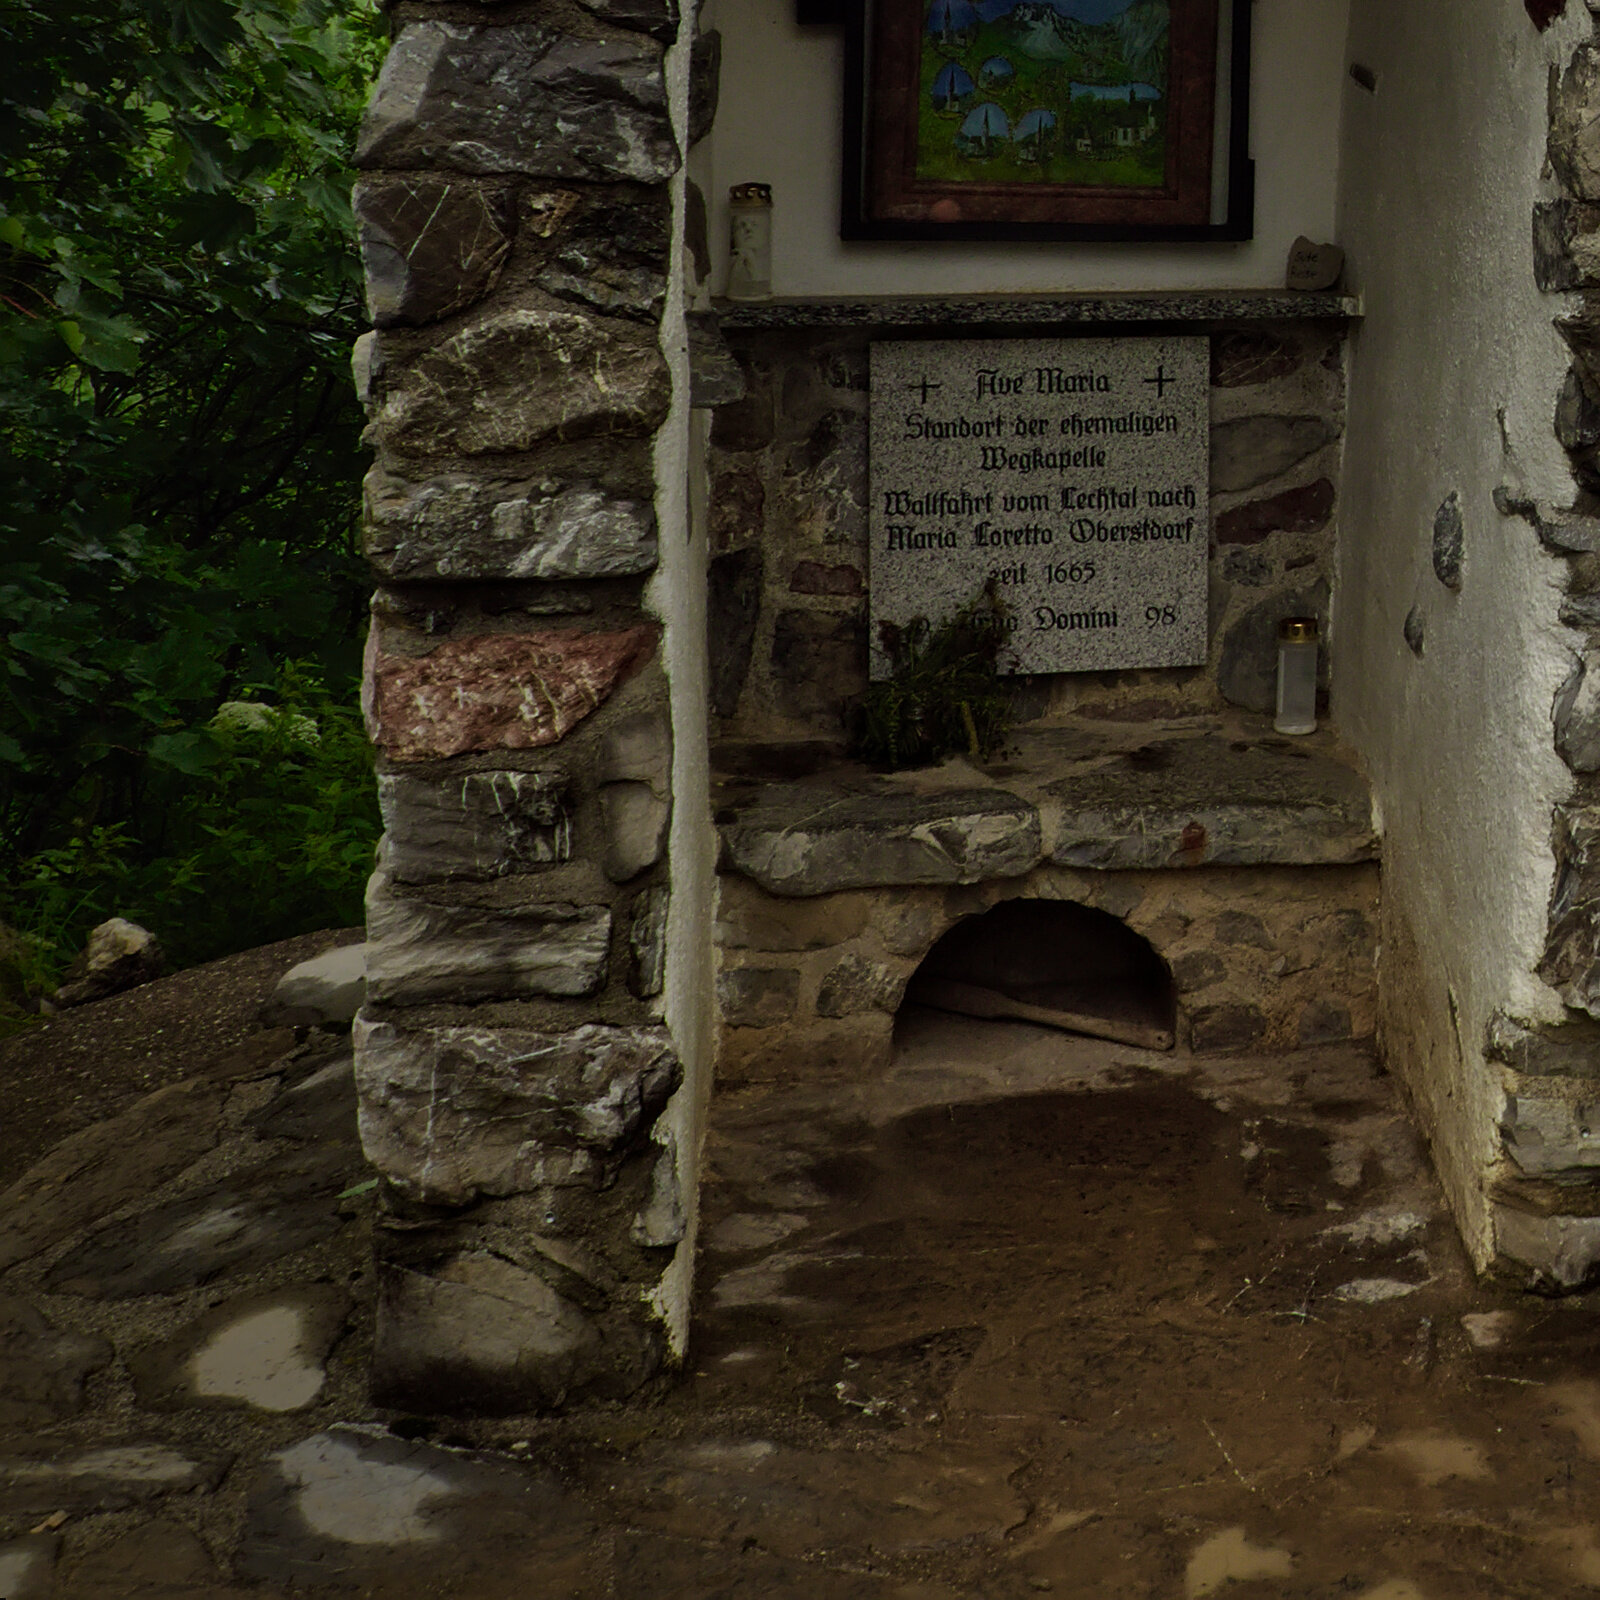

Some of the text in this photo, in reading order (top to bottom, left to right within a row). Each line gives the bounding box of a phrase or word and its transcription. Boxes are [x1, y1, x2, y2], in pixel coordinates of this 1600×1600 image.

[975, 367, 1111, 401] Ave Maria
[904, 411, 1179, 441] Standort der ehemaligen
[979, 444, 1107, 475] Wegkapelle
[883, 484, 1198, 518] Wallfahrt vom Lechtal nach
[886, 516, 1195, 551] Maria Loretto Oberstdorf
[1043, 559, 1097, 585] 1665
[1030, 605, 1119, 632] Domini
[1144, 604, 1177, 629] 98
